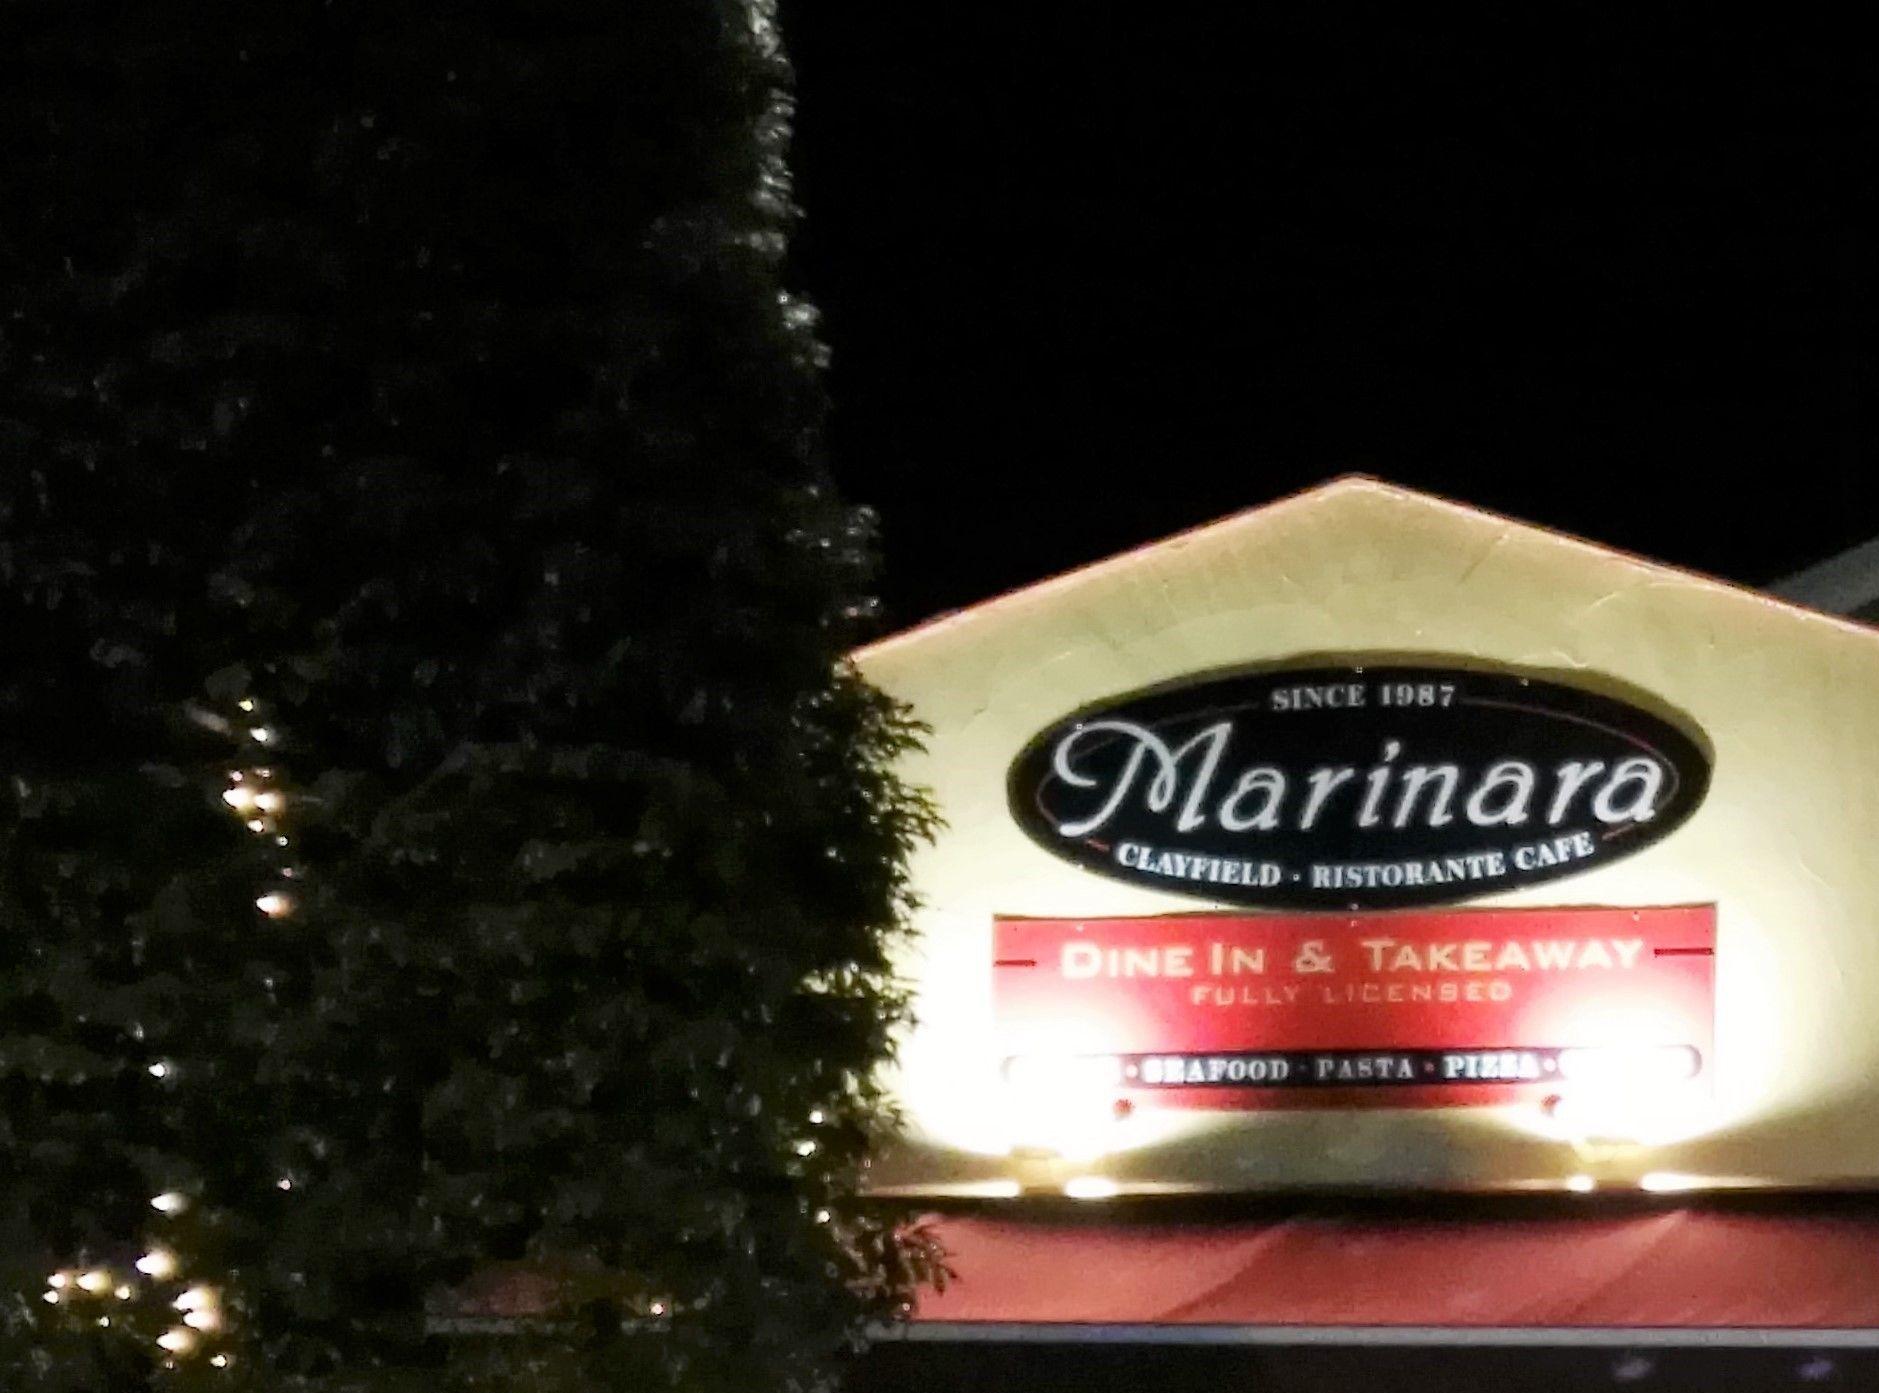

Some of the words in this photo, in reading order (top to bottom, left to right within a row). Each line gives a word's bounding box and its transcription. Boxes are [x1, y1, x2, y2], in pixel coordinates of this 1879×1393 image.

[1271, 685, 1365, 711] SINCE
[1380, 684, 1456, 708] 1987
[1053, 720, 1664, 837] Marinara
[1115, 842, 1282, 888] CLAYFIELD
[1311, 852, 1506, 890] RISTORANTE
[1514, 831, 1596, 871] CAFE
[1060, 942, 1194, 980] DINE
[1211, 943, 1265, 976] IN
[1295, 941, 1335, 974] &
[1361, 937, 1643, 973] TAKEAWAY
[1191, 986, 1300, 1006] FULLY
[1325, 981, 1512, 1003] LICENSED
[1317, 1057, 1415, 1080] PASTA
[1443, 1052, 1541, 1080] PIZZA
